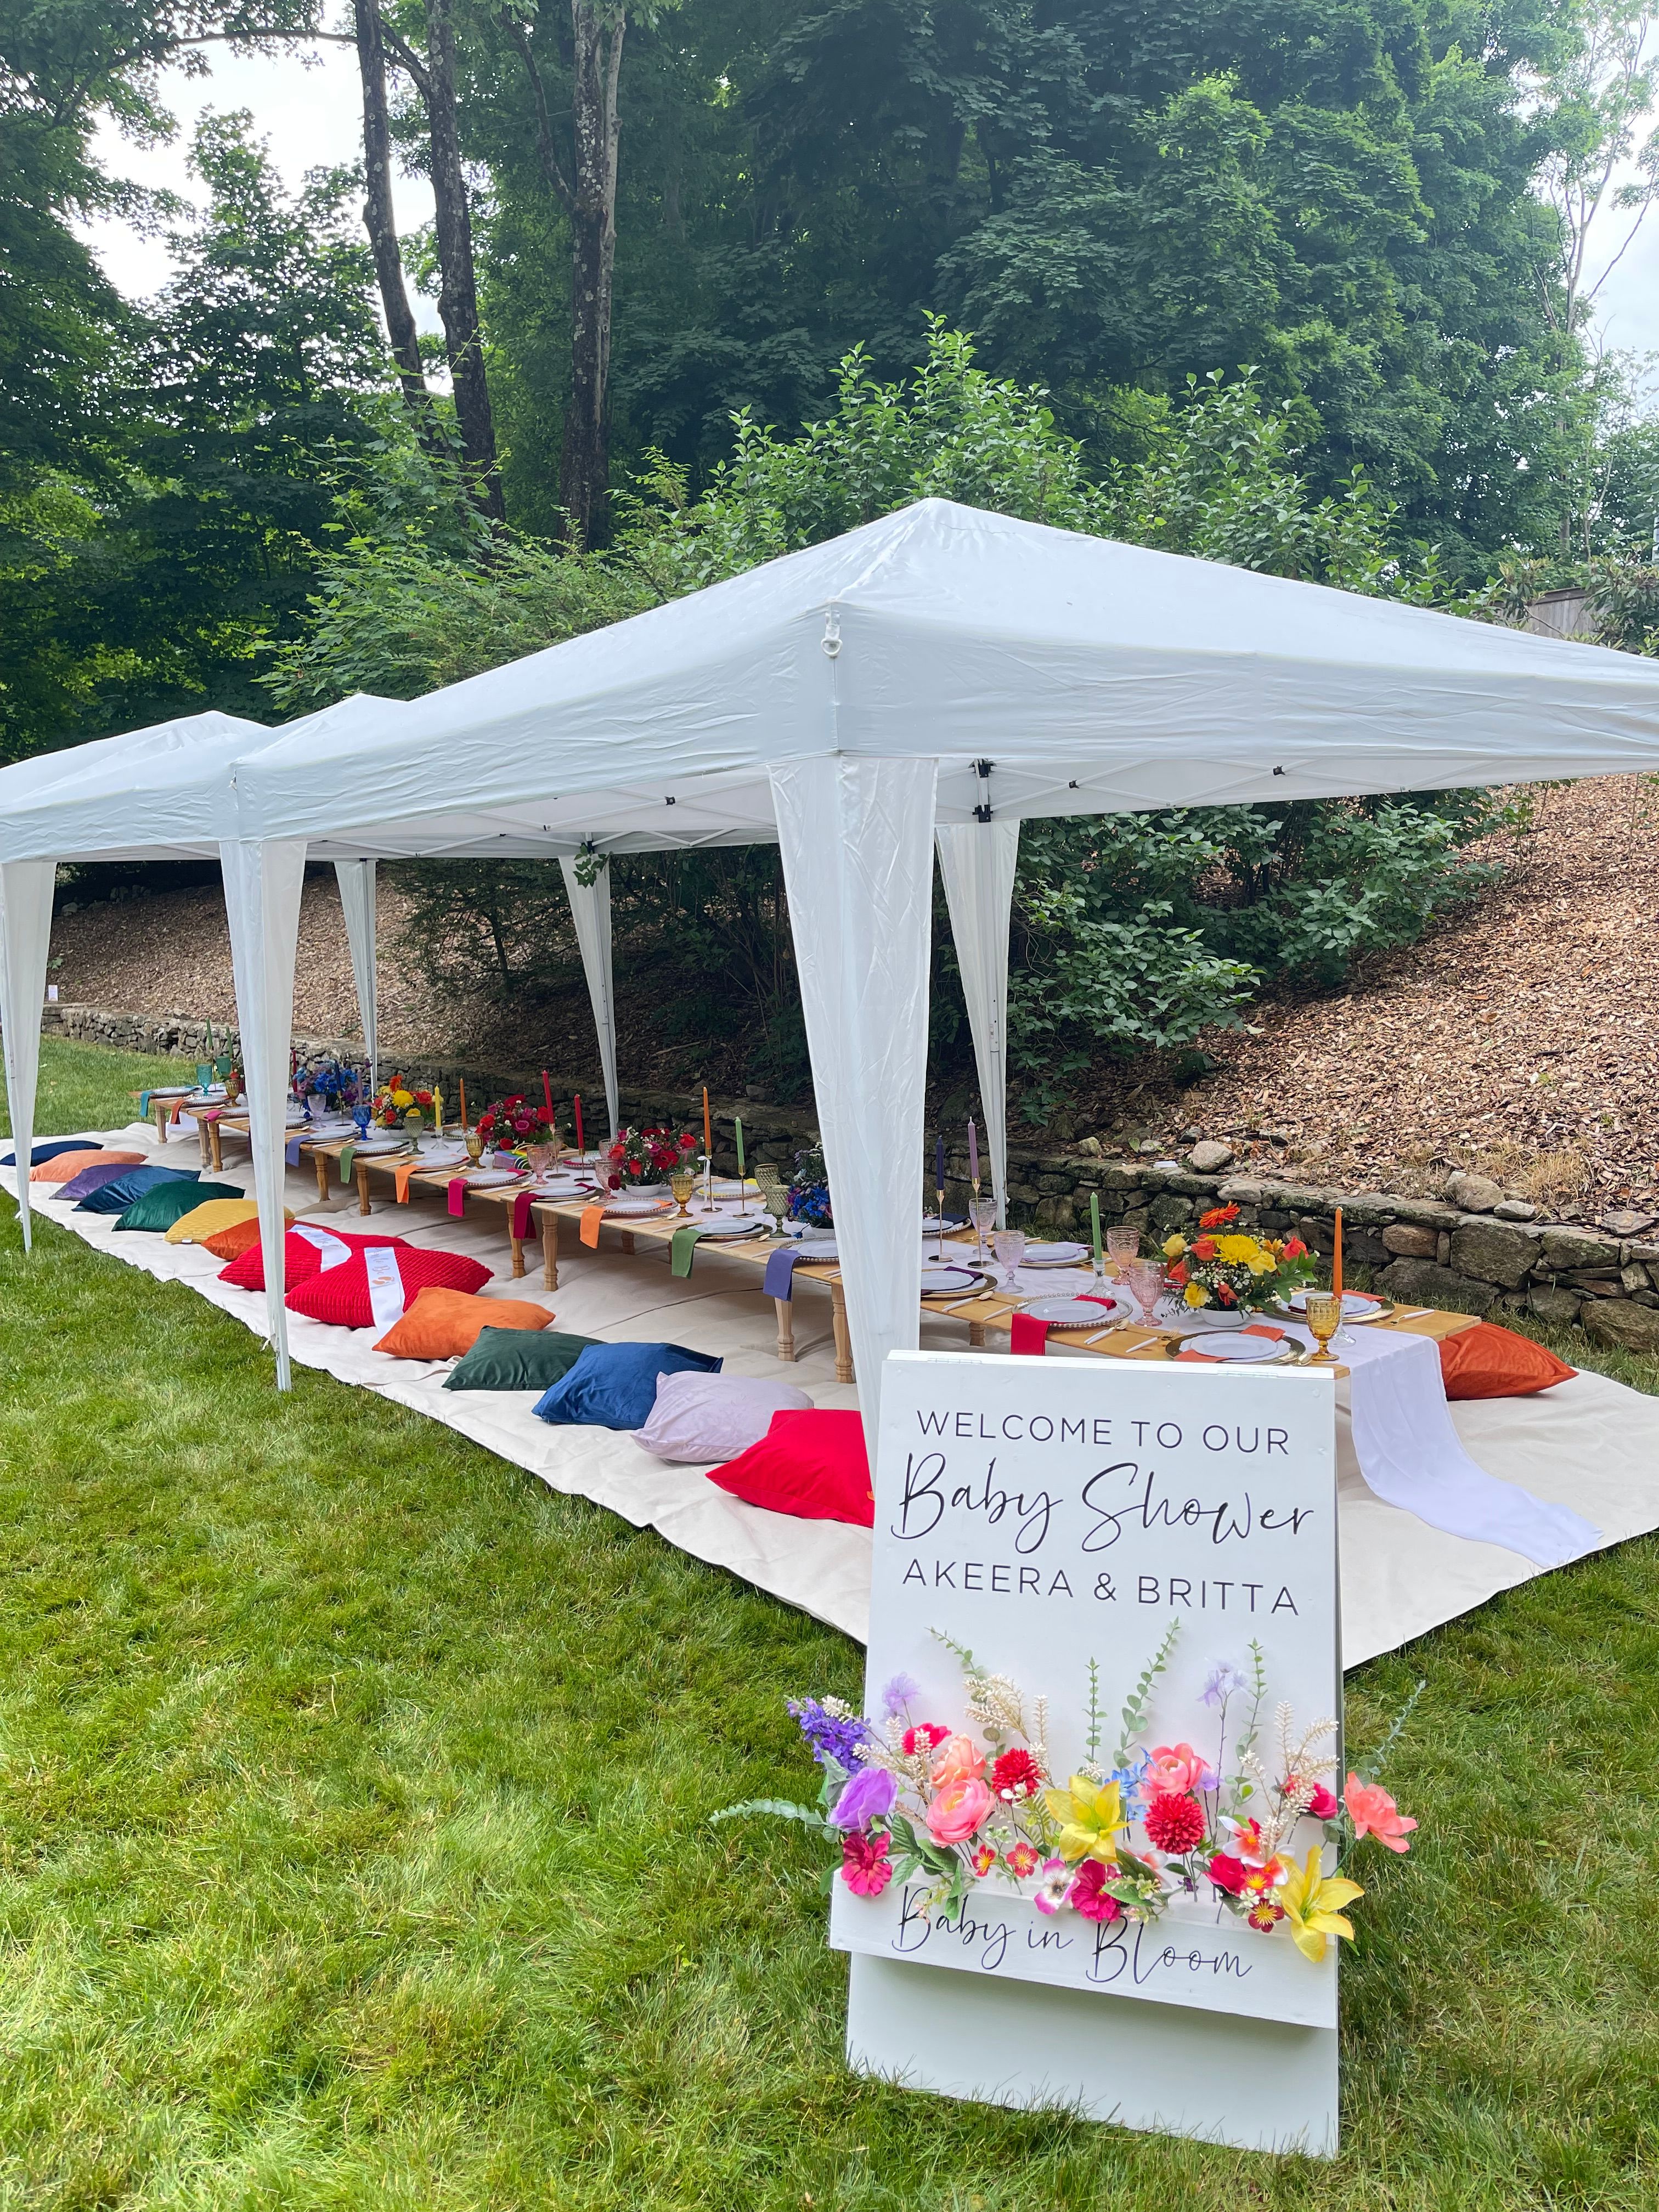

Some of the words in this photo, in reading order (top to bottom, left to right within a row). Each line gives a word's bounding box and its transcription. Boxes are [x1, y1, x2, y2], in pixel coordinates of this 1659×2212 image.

[917, 1410, 1112, 1446] WELCOME
[1130, 1420, 1183, 1449] TO
[1203, 1424, 1289, 1455] OUR
[890, 1452, 1063, 1554] Baby
[1081, 1462, 1314, 1552] Shower
[902, 1558, 1074, 1598] AKEERA
[1093, 1572, 1117, 1602] &
[1138, 1575, 1300, 1616] BRITTA
[891, 1885, 1017, 1970] Baby
[1027, 1920, 1074, 1950] in
[1085, 1915, 1252, 1984] Bloom
